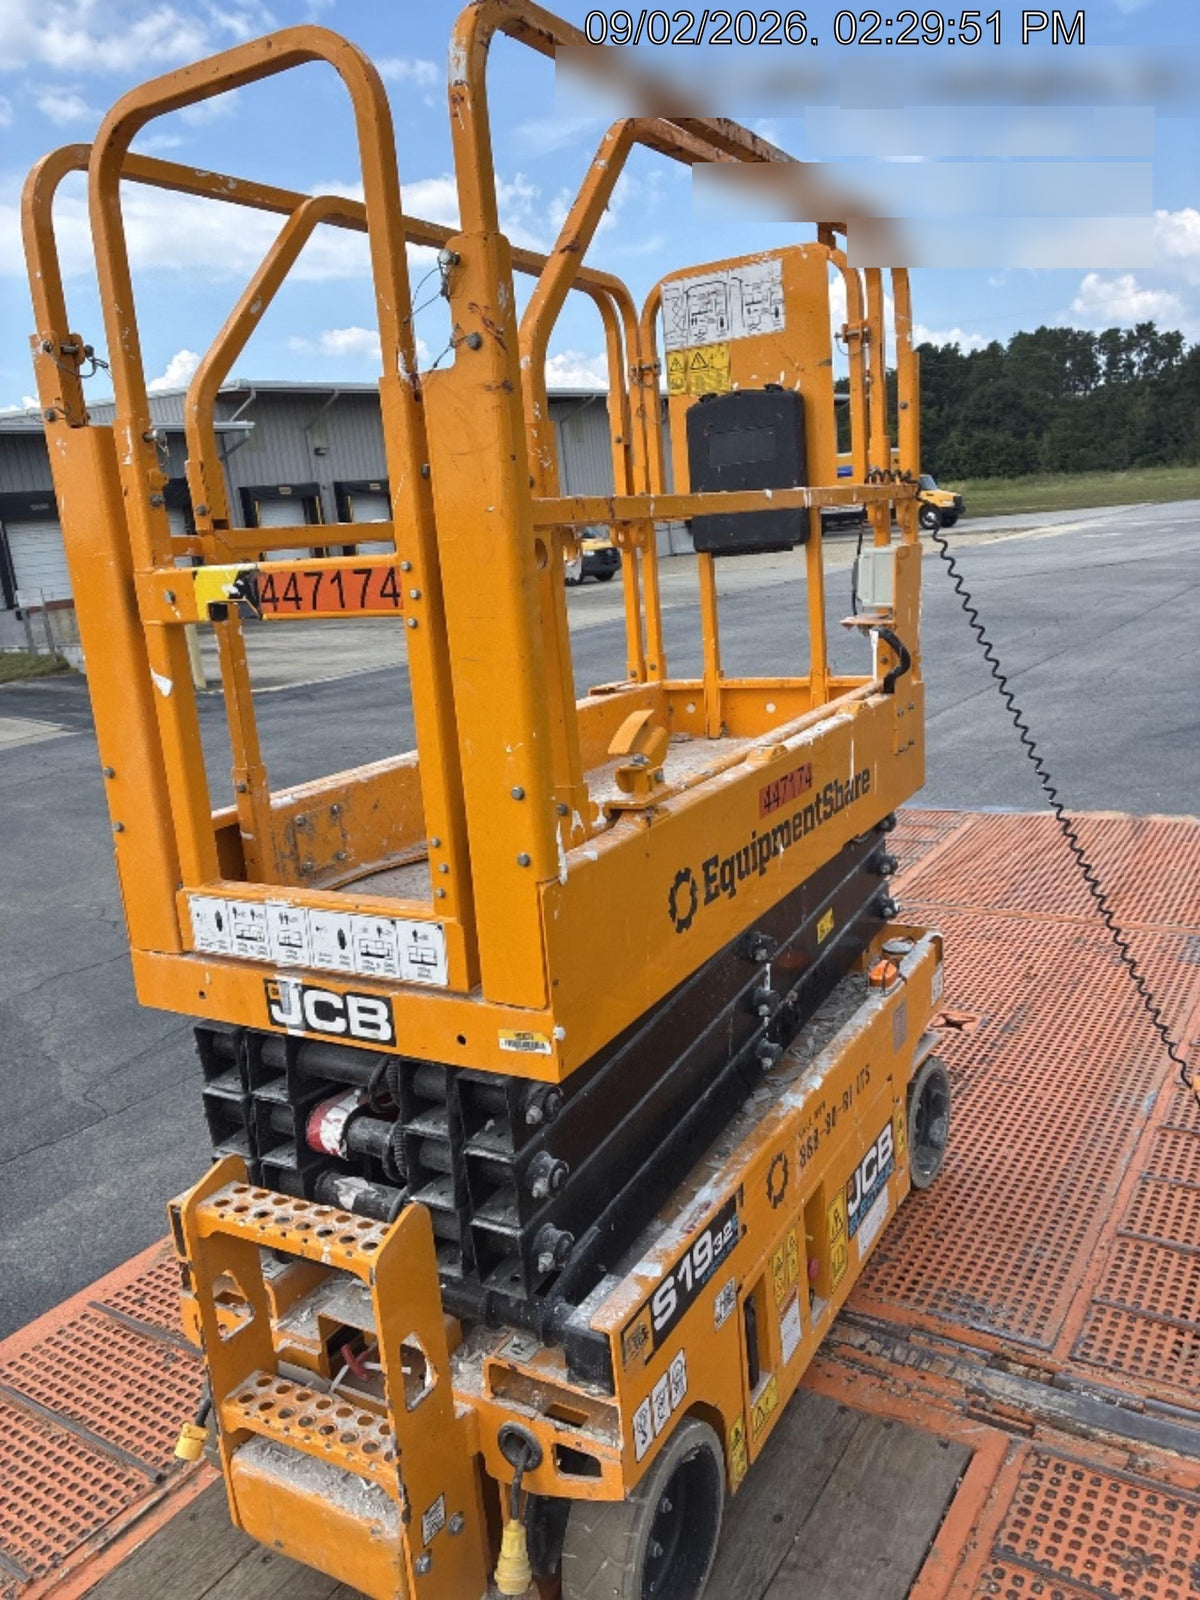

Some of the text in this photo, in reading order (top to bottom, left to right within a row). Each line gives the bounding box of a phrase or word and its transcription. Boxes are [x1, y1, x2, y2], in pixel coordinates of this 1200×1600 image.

[260, 566, 401, 612] 447174
[763, 762, 813, 814] 447174
[702, 767, 871, 907] EquipmentShare
[270, 979, 393, 1042] JCB
[847, 1122, 894, 1218] JCB
